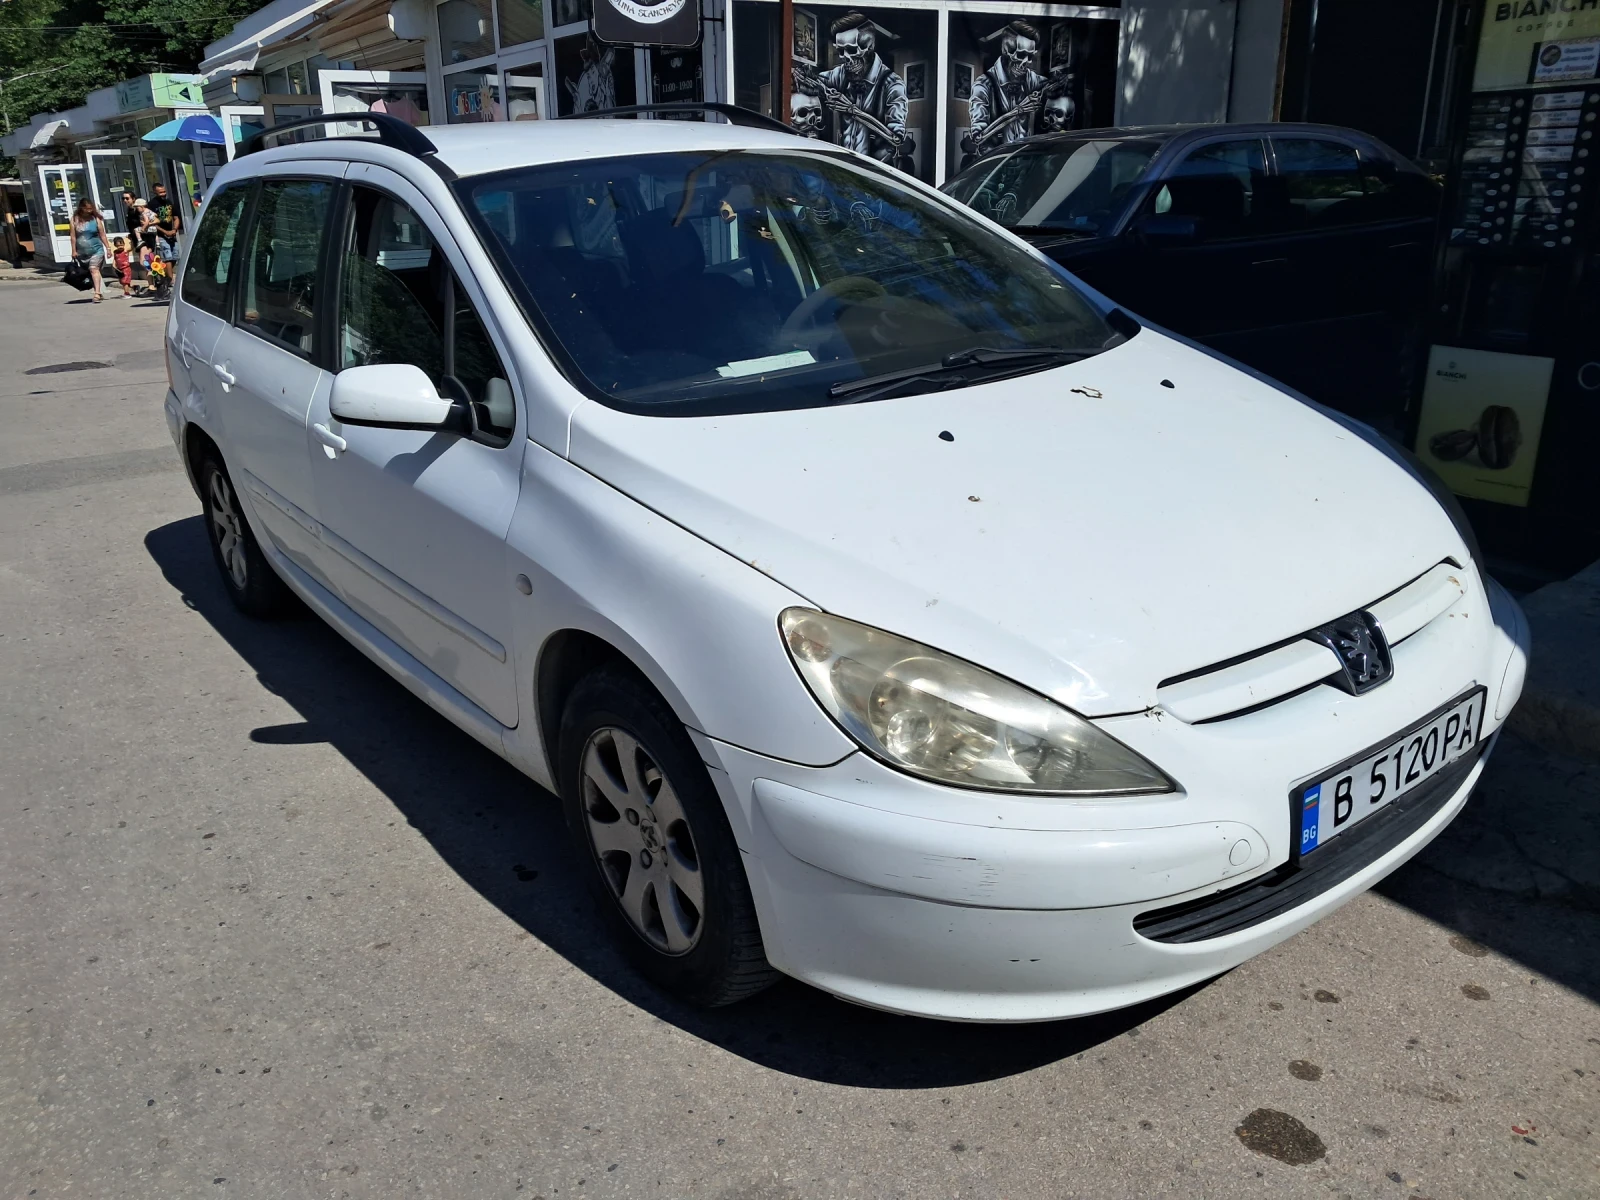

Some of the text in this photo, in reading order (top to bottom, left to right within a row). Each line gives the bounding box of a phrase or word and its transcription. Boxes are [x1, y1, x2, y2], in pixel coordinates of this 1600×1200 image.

[1495, 0, 1600, 21] BIANCH
[1516, 19, 1574, 33] COFFEE
[1436, 369, 1467, 380] BIANCHI
[1333, 775, 1353, 828] B
[1302, 824, 1317, 844] BG
